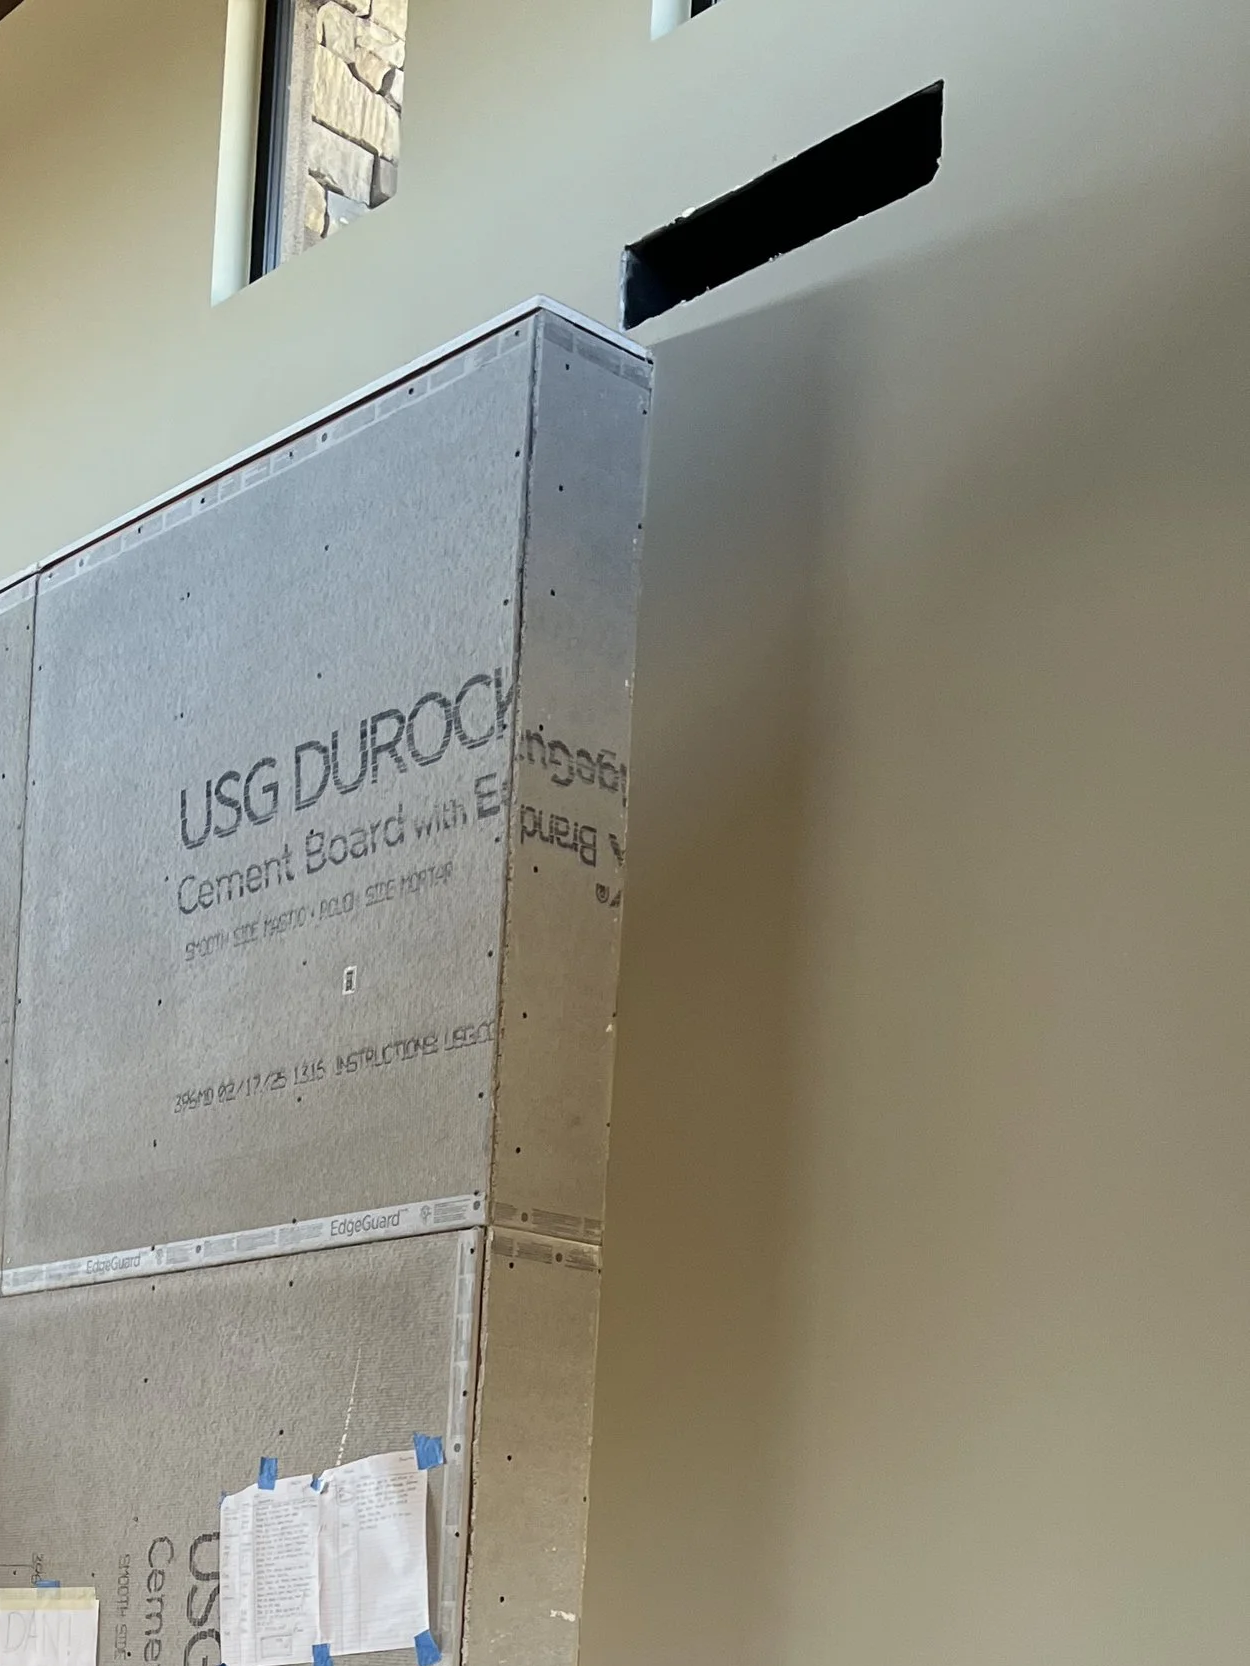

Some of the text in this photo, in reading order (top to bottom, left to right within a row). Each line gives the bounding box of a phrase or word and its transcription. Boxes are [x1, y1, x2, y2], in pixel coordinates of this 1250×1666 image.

[180, 757, 279, 849] USG
[178, 843, 295, 914] Cement
[307, 802, 405, 875] Board
[414, 798, 467, 839] with
[520, 804, 597, 868] Brand
[119, 1554, 131, 1617] SMOOTH
[114, 1624, 128, 1660] SIDE
